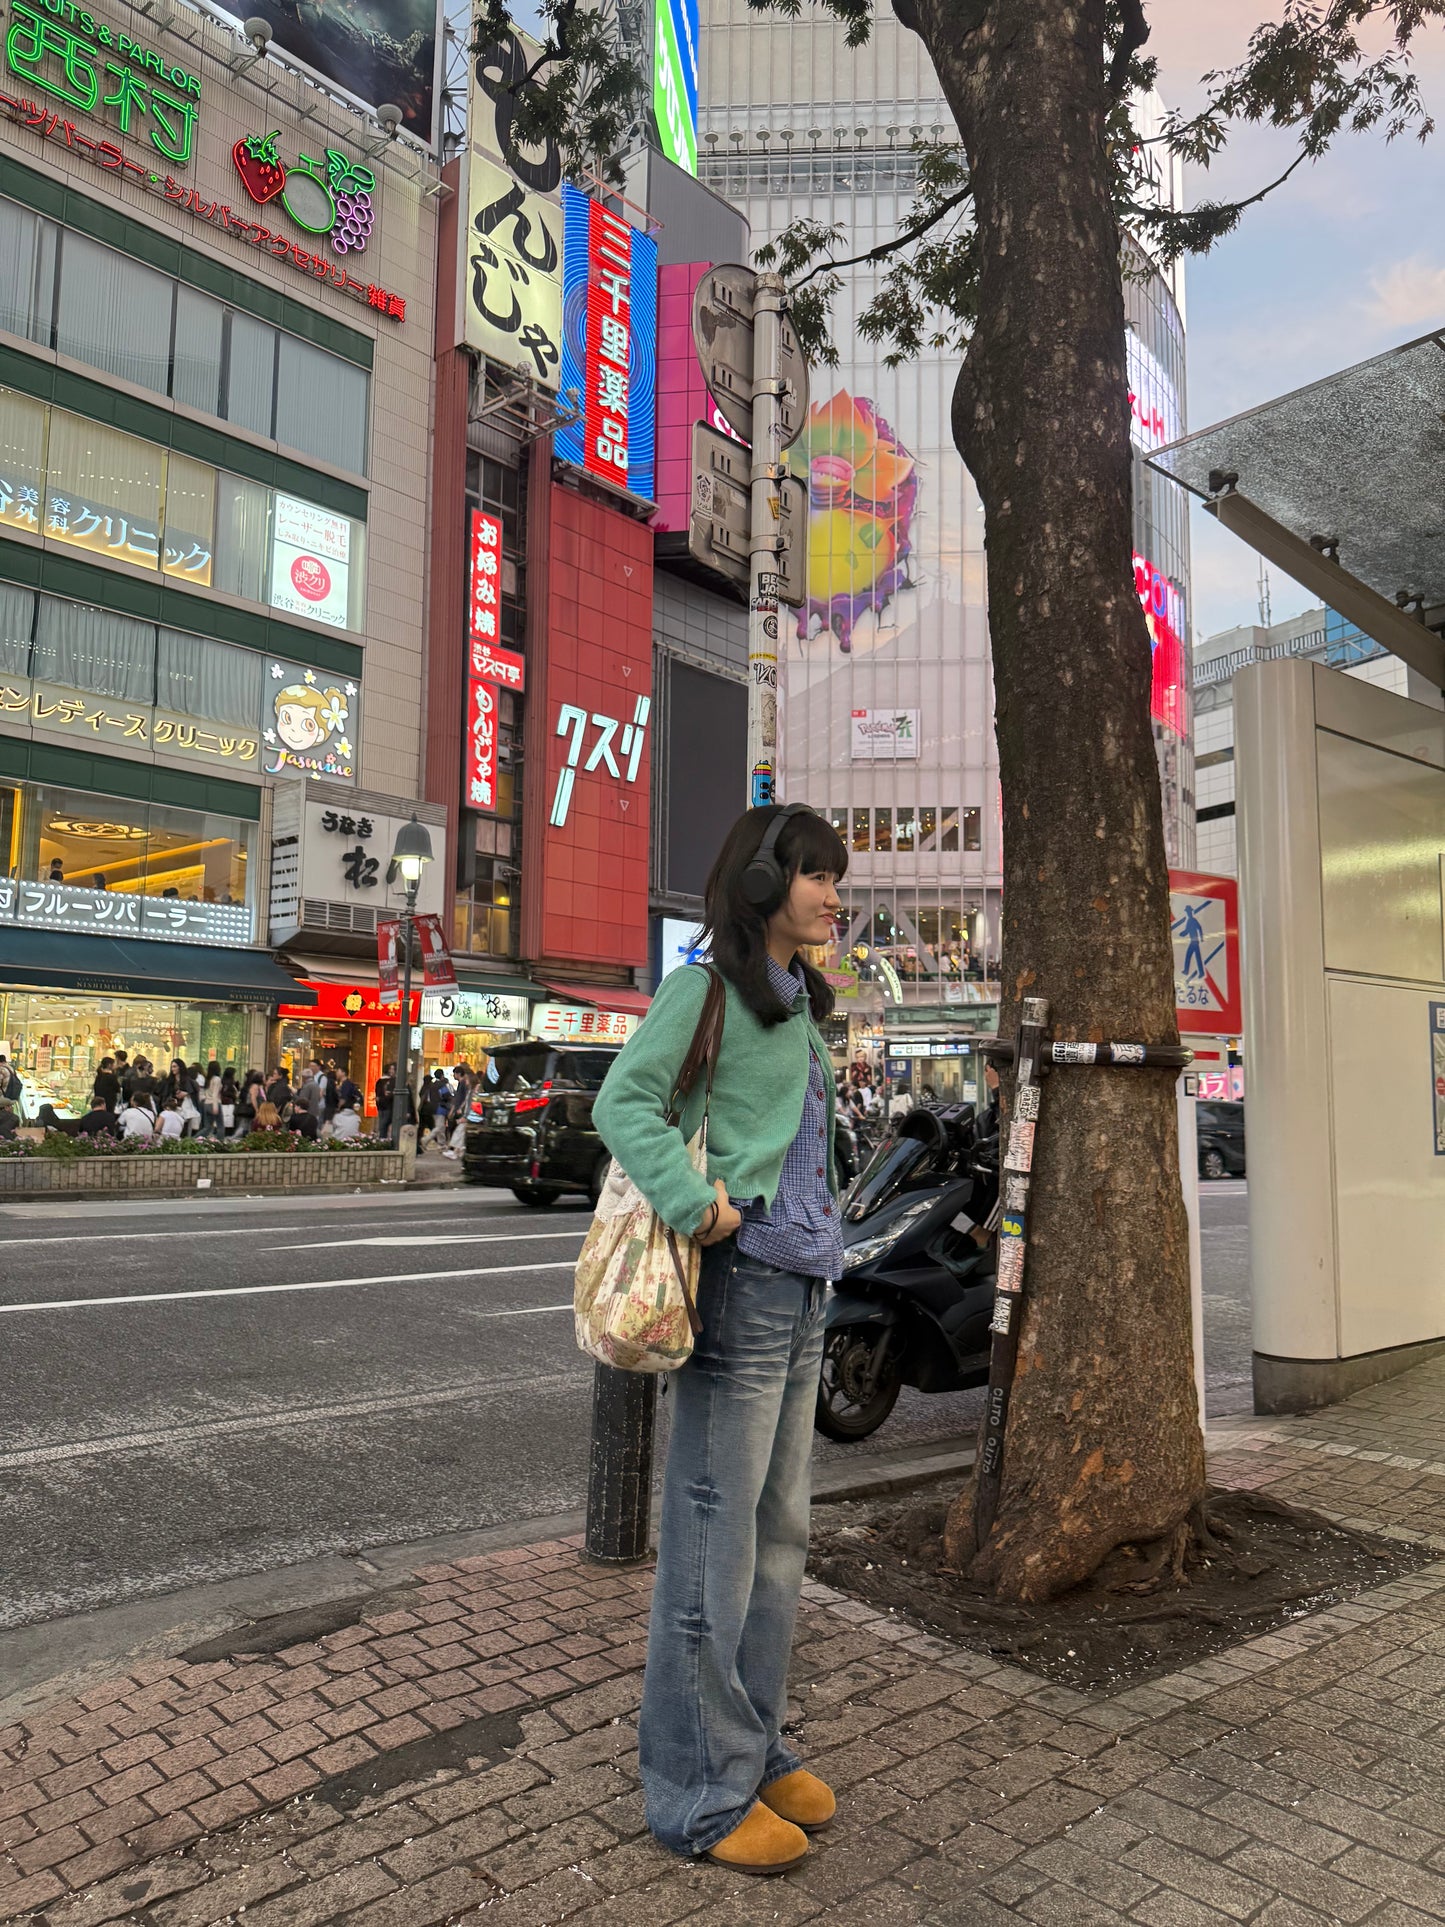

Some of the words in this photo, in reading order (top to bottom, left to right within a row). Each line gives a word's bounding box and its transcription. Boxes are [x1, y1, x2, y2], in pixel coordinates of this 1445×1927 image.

[6, 2, 200, 162] 西村
[39, 0, 96, 35] UITS
[98, 25, 114, 47] &
[119, 33, 203, 99] PARLOR
[597, 213, 631, 470] 三千里薬品
[72, 505, 212, 572] クリニック
[475, 517, 498, 637] お好み焼
[762, 573, 779, 586] BE
[264, 745, 354, 778] Jasmine
[471, 684, 494, 806] もんじゃ焼
[550, 695, 652, 827] クスリ
[321, 811, 375, 838] うなぎ
[76, 981, 131, 992] NISHIMURA
[544, 1010, 628, 1035] 三千里薬品
[989, 1387, 1004, 1427] CLITO
